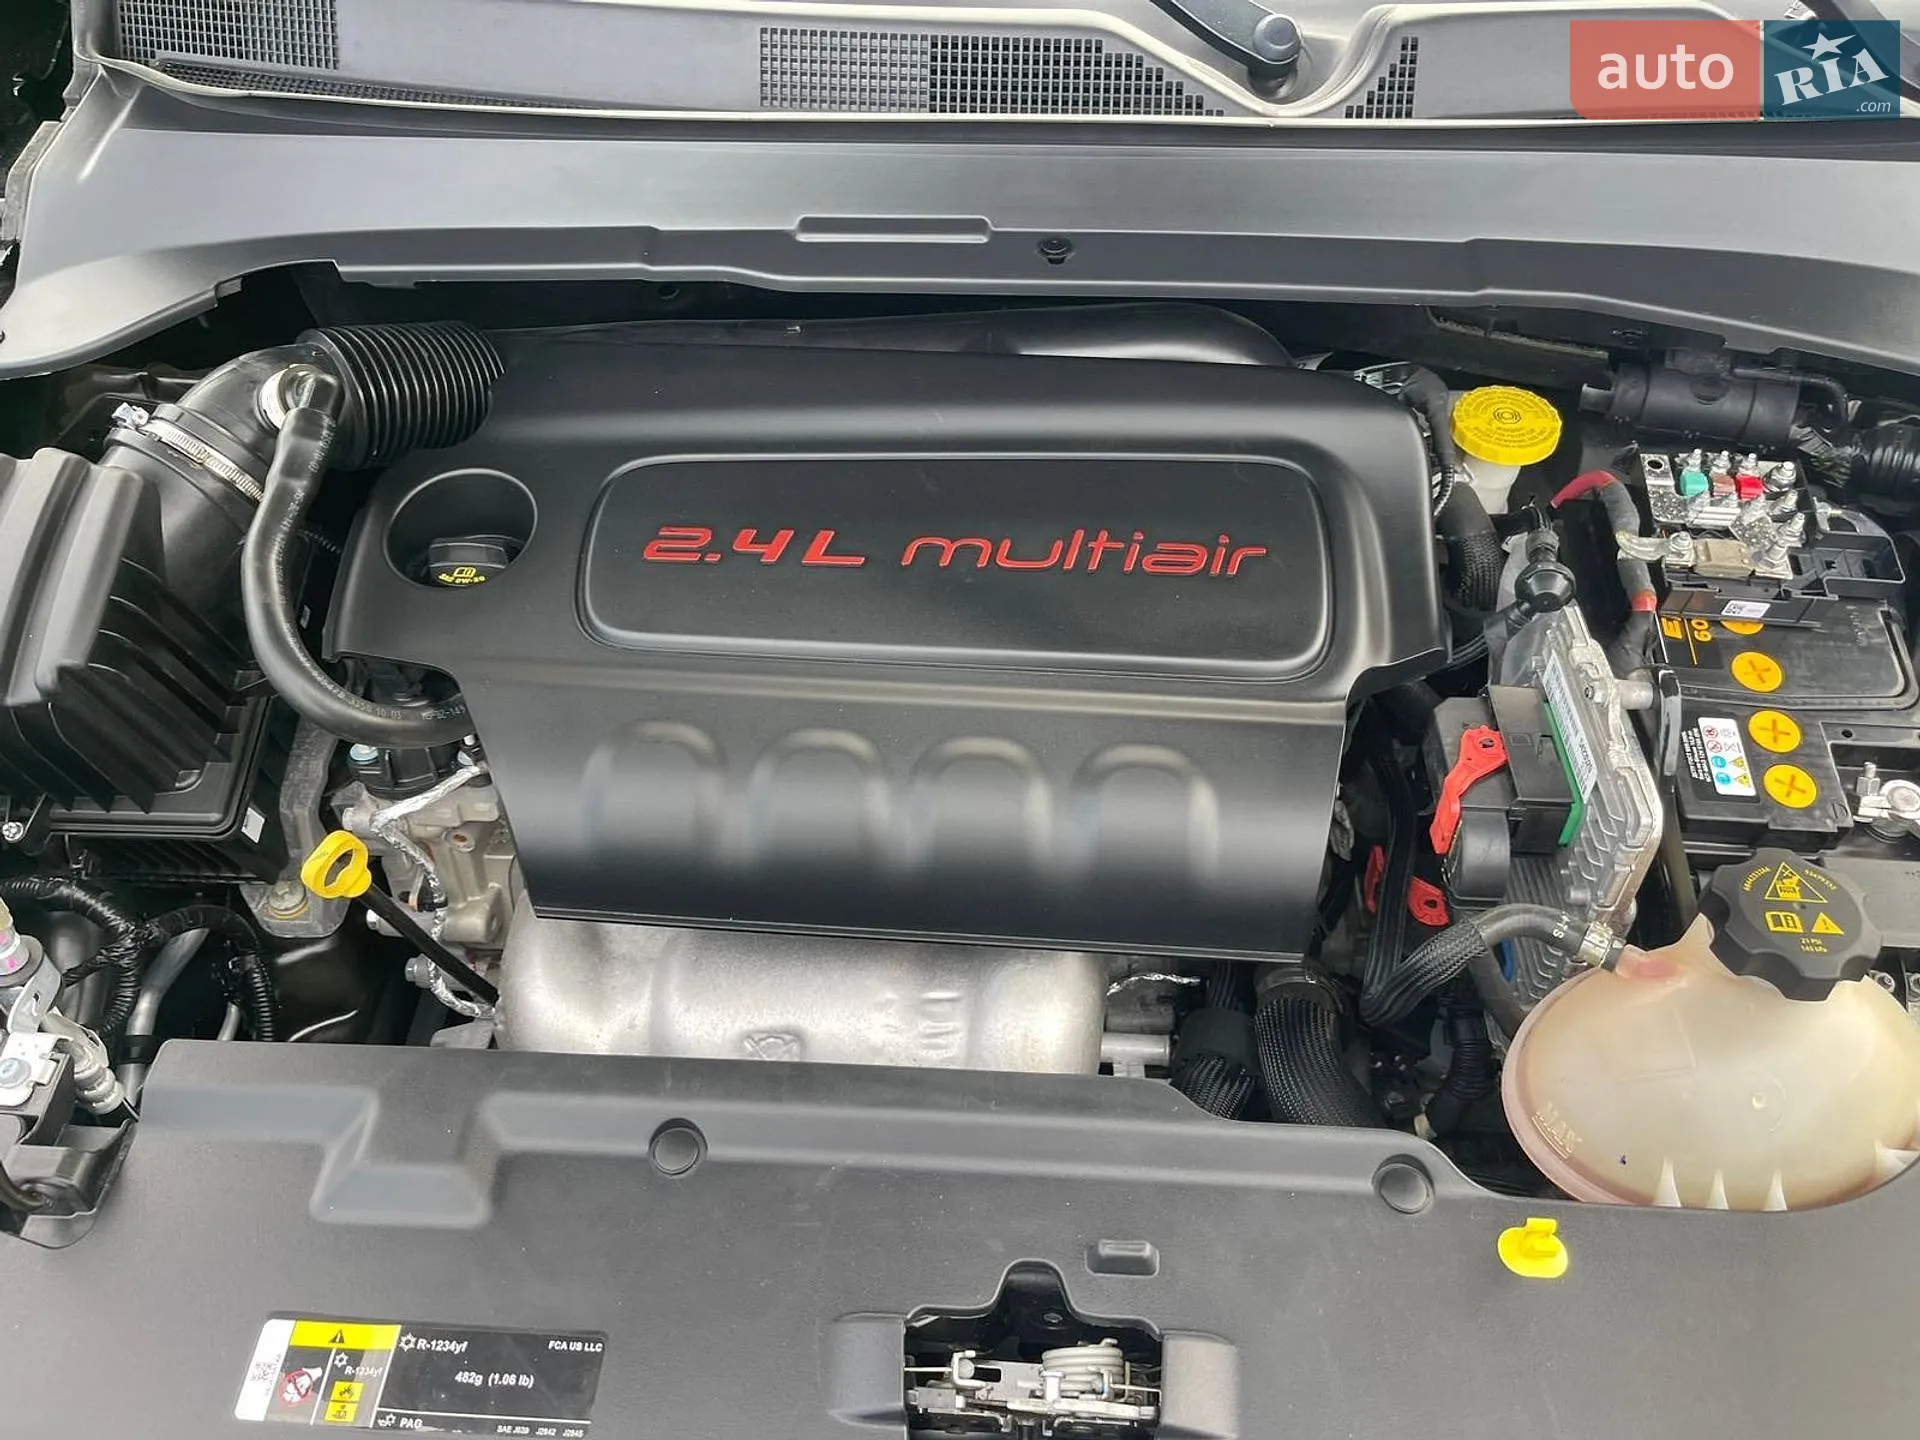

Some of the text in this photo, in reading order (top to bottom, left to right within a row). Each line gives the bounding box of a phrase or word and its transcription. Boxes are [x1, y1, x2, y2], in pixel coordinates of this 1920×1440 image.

[643, 525, 1267, 577] 2.4L multiair
[416, 1339, 469, 1355] R-1234yf
[548, 1340, 603, 1353] FCA US LLC
[454, 1370, 484, 1387] 482g
[517, 1374, 535, 1389] lb)
